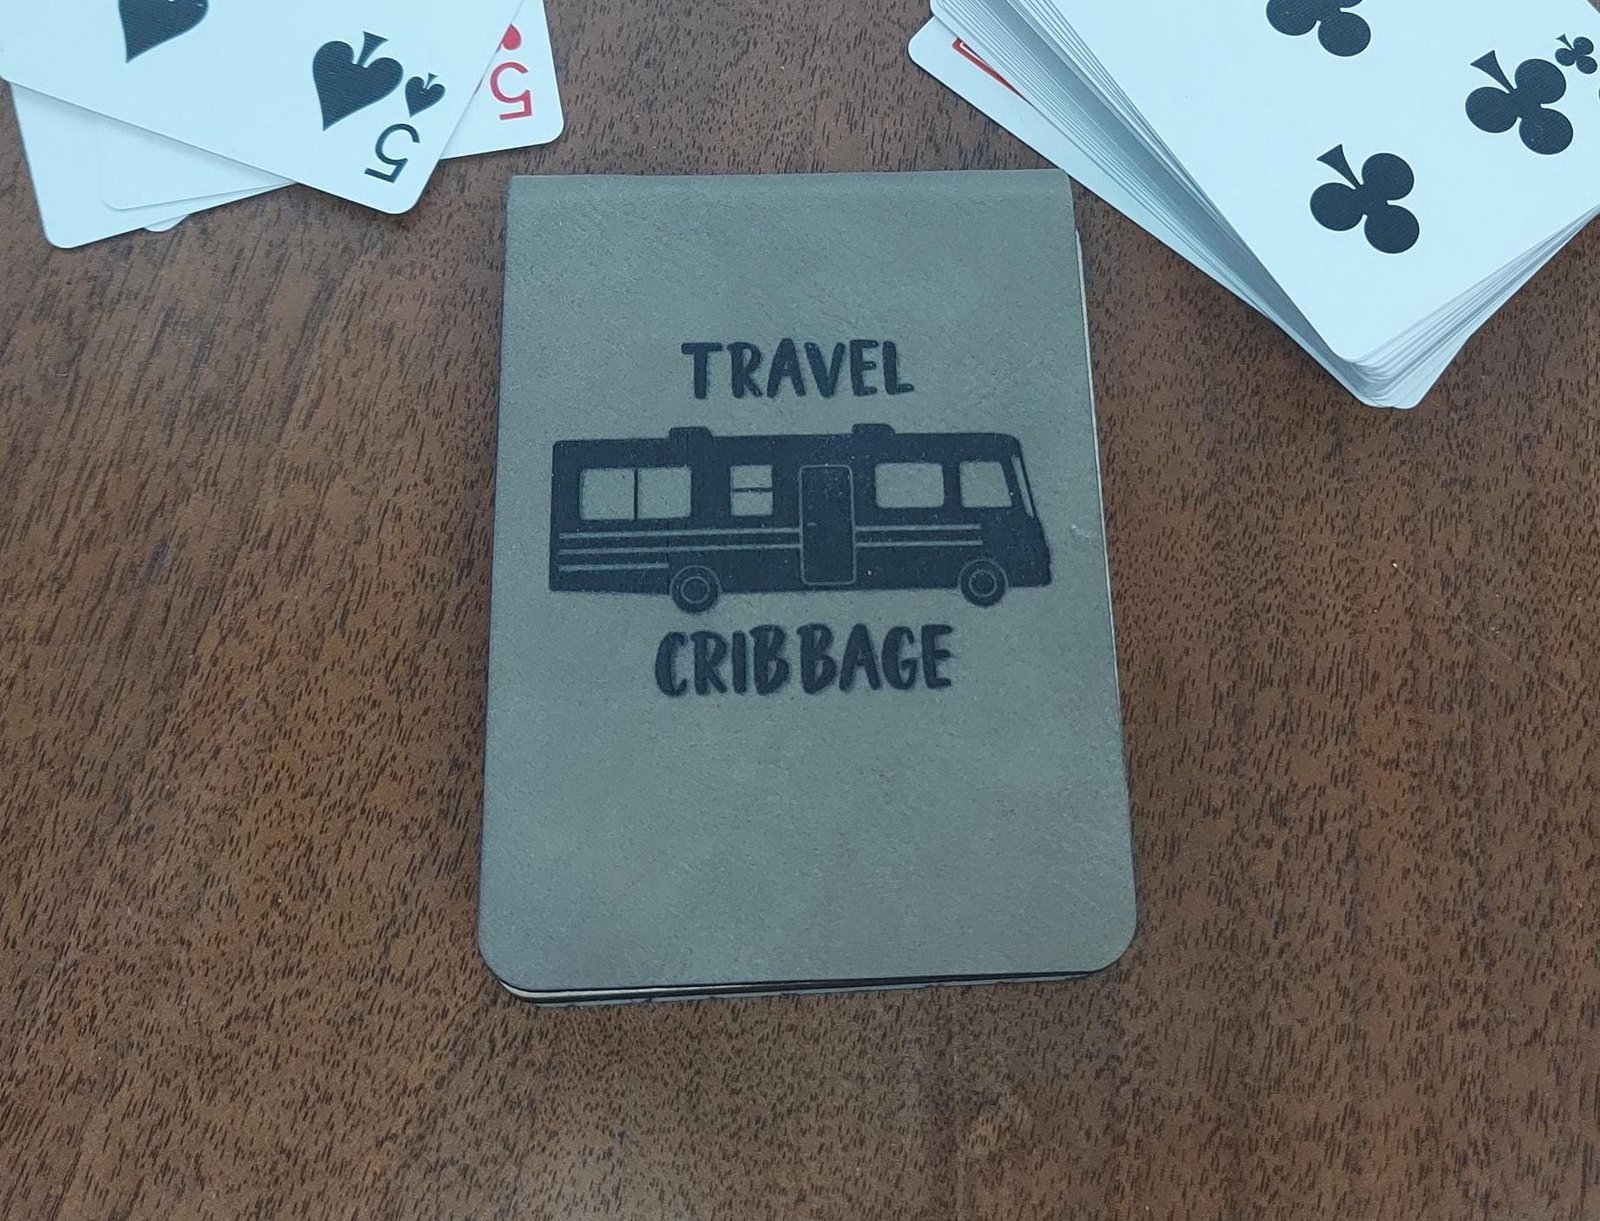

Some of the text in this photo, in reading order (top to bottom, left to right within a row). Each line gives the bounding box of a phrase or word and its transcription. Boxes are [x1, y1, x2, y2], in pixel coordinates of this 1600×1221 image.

[490, 61, 532, 120] 5
[364, 123, 420, 183] 5
[681, 338, 915, 399] TRAVEL
[655, 623, 954, 697] CRIBBAGE
